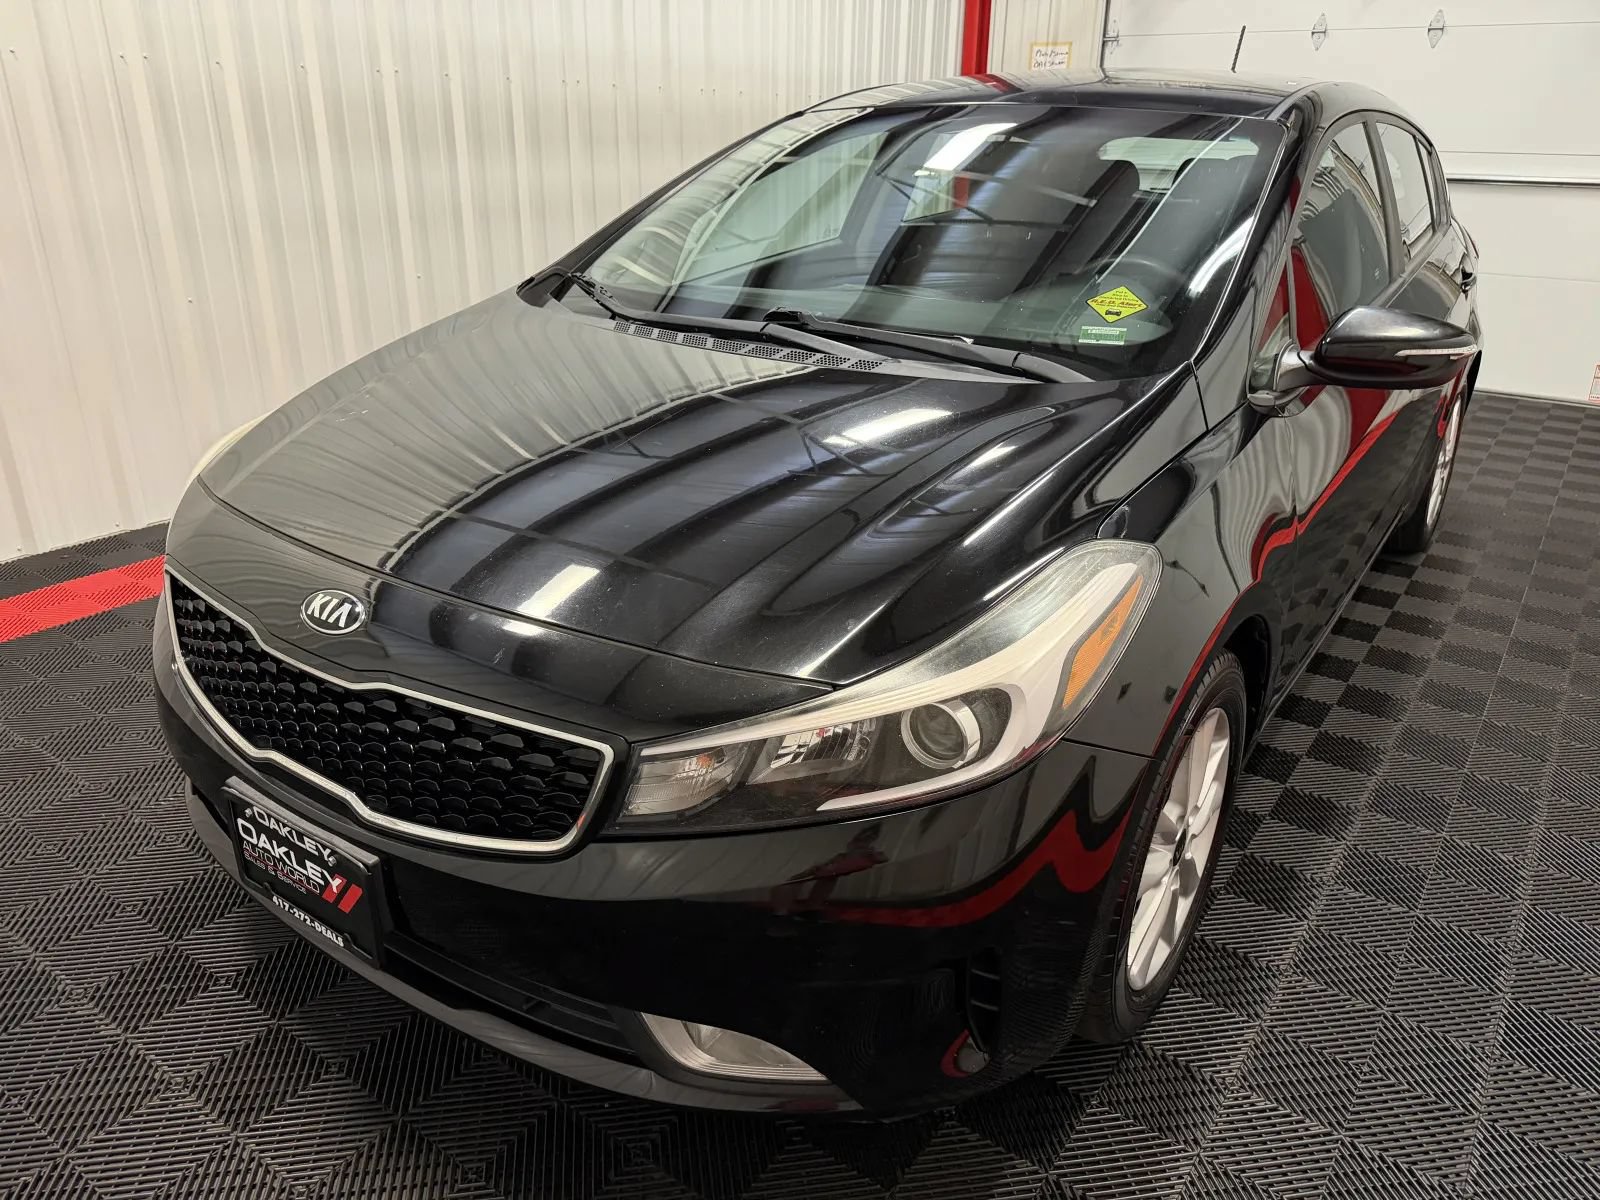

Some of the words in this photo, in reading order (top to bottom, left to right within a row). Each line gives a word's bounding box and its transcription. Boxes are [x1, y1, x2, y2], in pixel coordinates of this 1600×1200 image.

[306, 593, 353, 628] KIA
[237, 817, 343, 894] OAKLEY
[253, 805, 332, 862] OAKLEY
[243, 840, 274, 866] AUTO
[274, 858, 320, 894] WORLD
[268, 865, 276, 876] &
[272, 895, 345, 948] 417-272-DEALS
